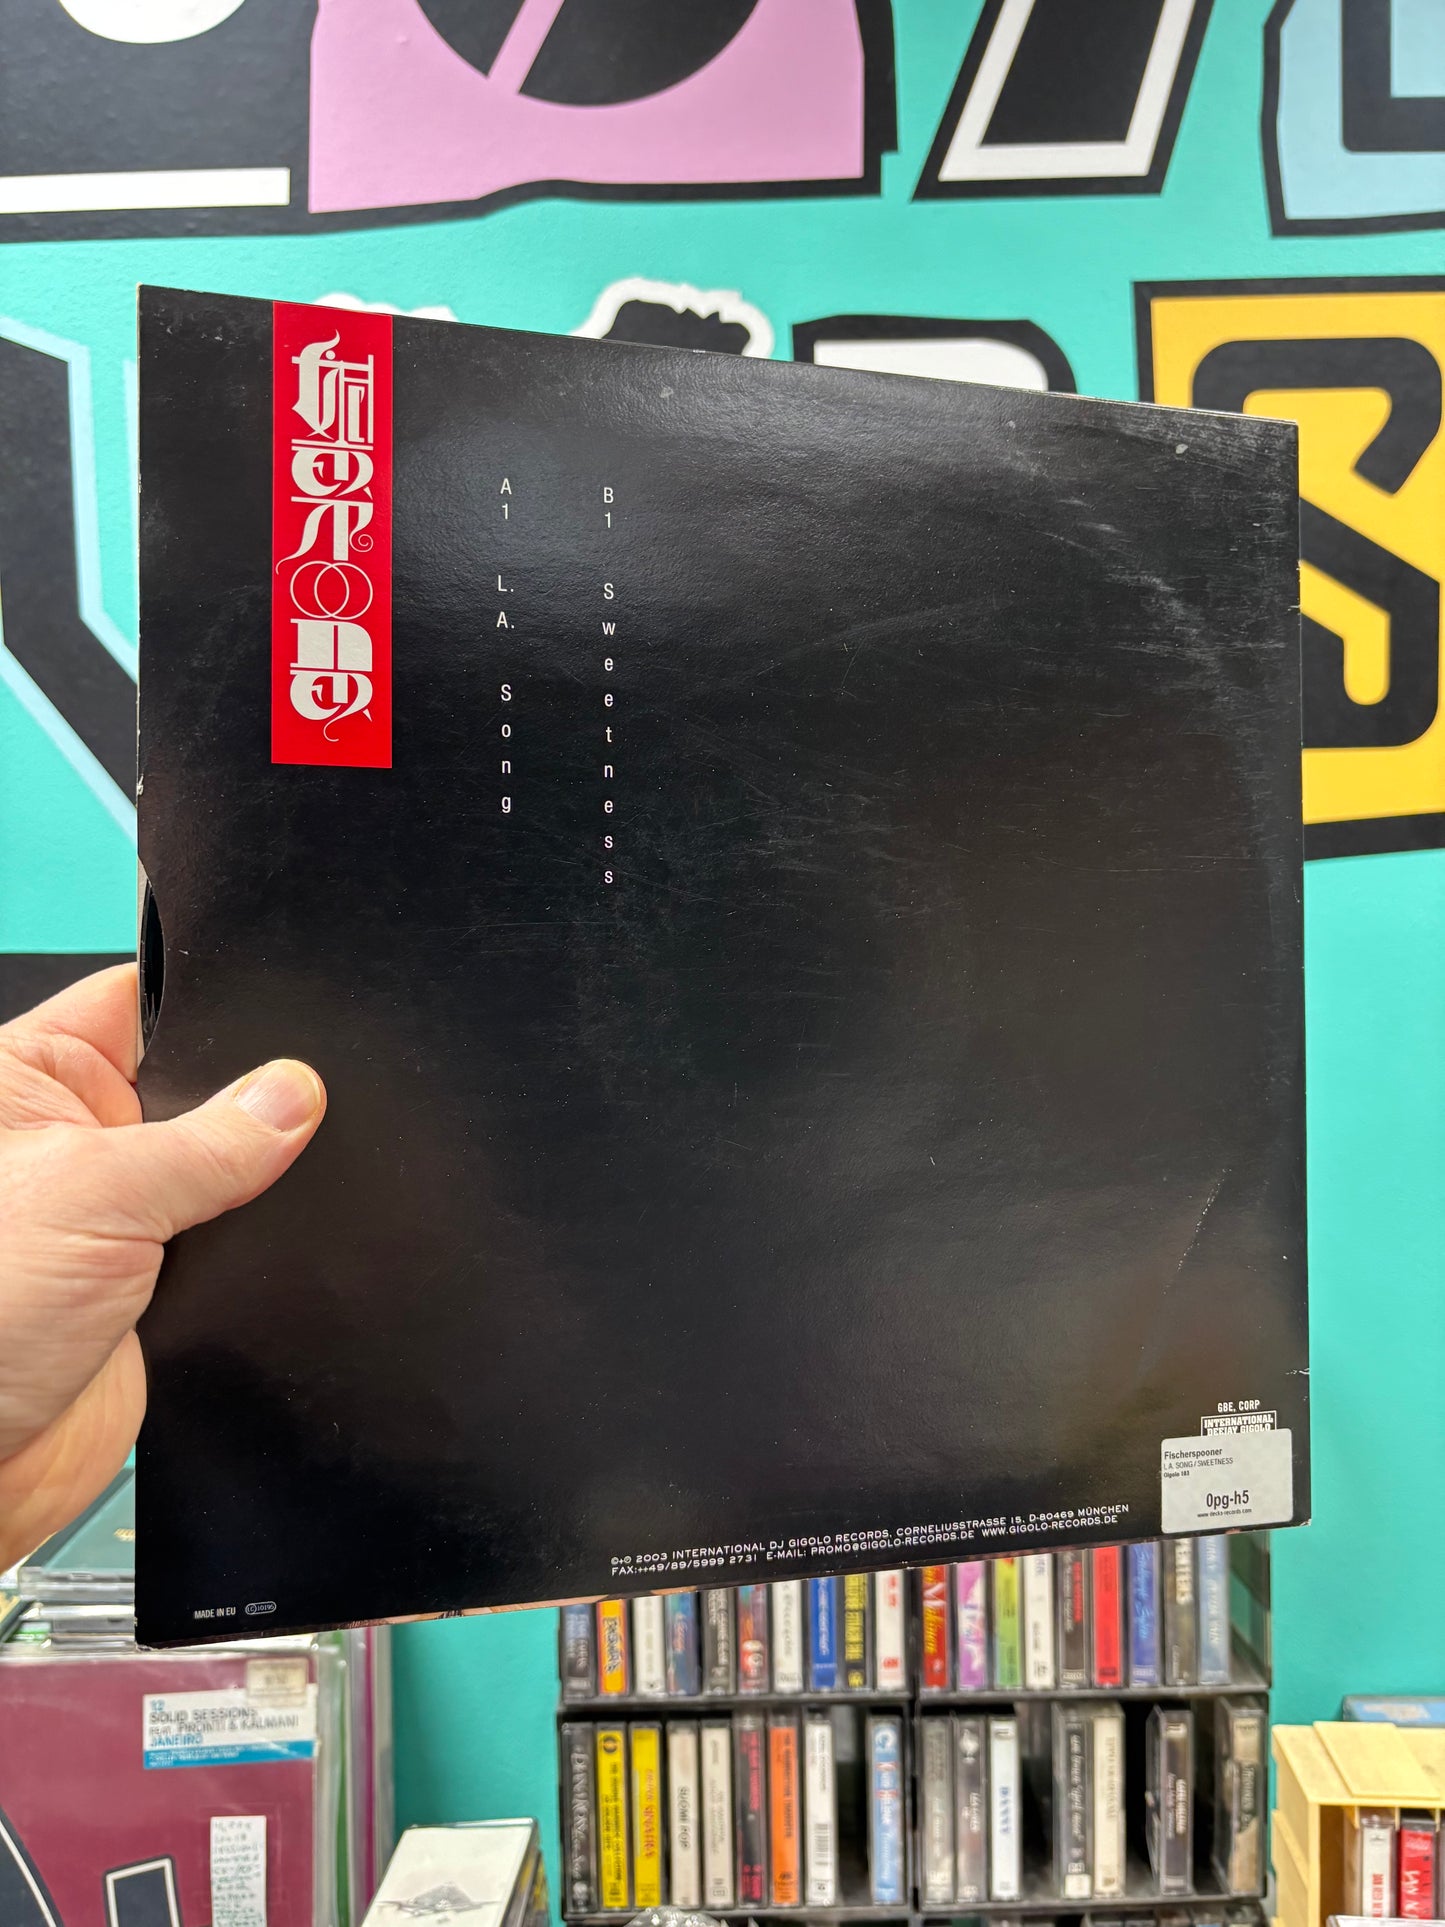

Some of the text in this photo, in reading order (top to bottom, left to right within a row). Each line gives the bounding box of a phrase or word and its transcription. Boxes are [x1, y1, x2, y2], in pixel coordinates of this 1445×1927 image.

[602, 583, 616, 884] Sweetness
[1238, 1400, 1260, 1411] CORP
[1204, 1414, 1274, 1429] INTERNATIONAL
[1207, 1423, 1271, 1437] DEEJAY GIGOLO
[1164, 1449, 1223, 1460] Fischerspooner
[1175, 1460, 1193, 1470] SONG
[1197, 1457, 1234, 1467] SWEETNESS
[636, 1552, 668, 1564] 2003
[672, 1542, 766, 1560] INTERNATIONAL
[769, 1540, 785, 1550] DJ
[788, 1535, 831, 1549] GIGOLO
[896, 1516, 1007, 1537] CORNELIUSSTRASSE
[1029, 1510, 1075, 1523] D-80469
[1077, 1503, 1130, 1517] MÜNCHEN
[729, 1553, 758, 1564] 2731
[766, 1549, 808, 1562] E-MAIL:
[811, 1530, 975, 1557] PROMO@GIGOLO-RECORDS.DE
[981, 1515, 1118, 1538] WWW.GIGOLO-RECORDS.DE
[194, 1608, 215, 1619] MADE
[216, 1607, 225, 1617] IN
[226, 1607, 237, 1616] EU
[150, 1707, 258, 1724] SOLID SESSIONS
[151, 1733, 204, 1746] JANEIRO
